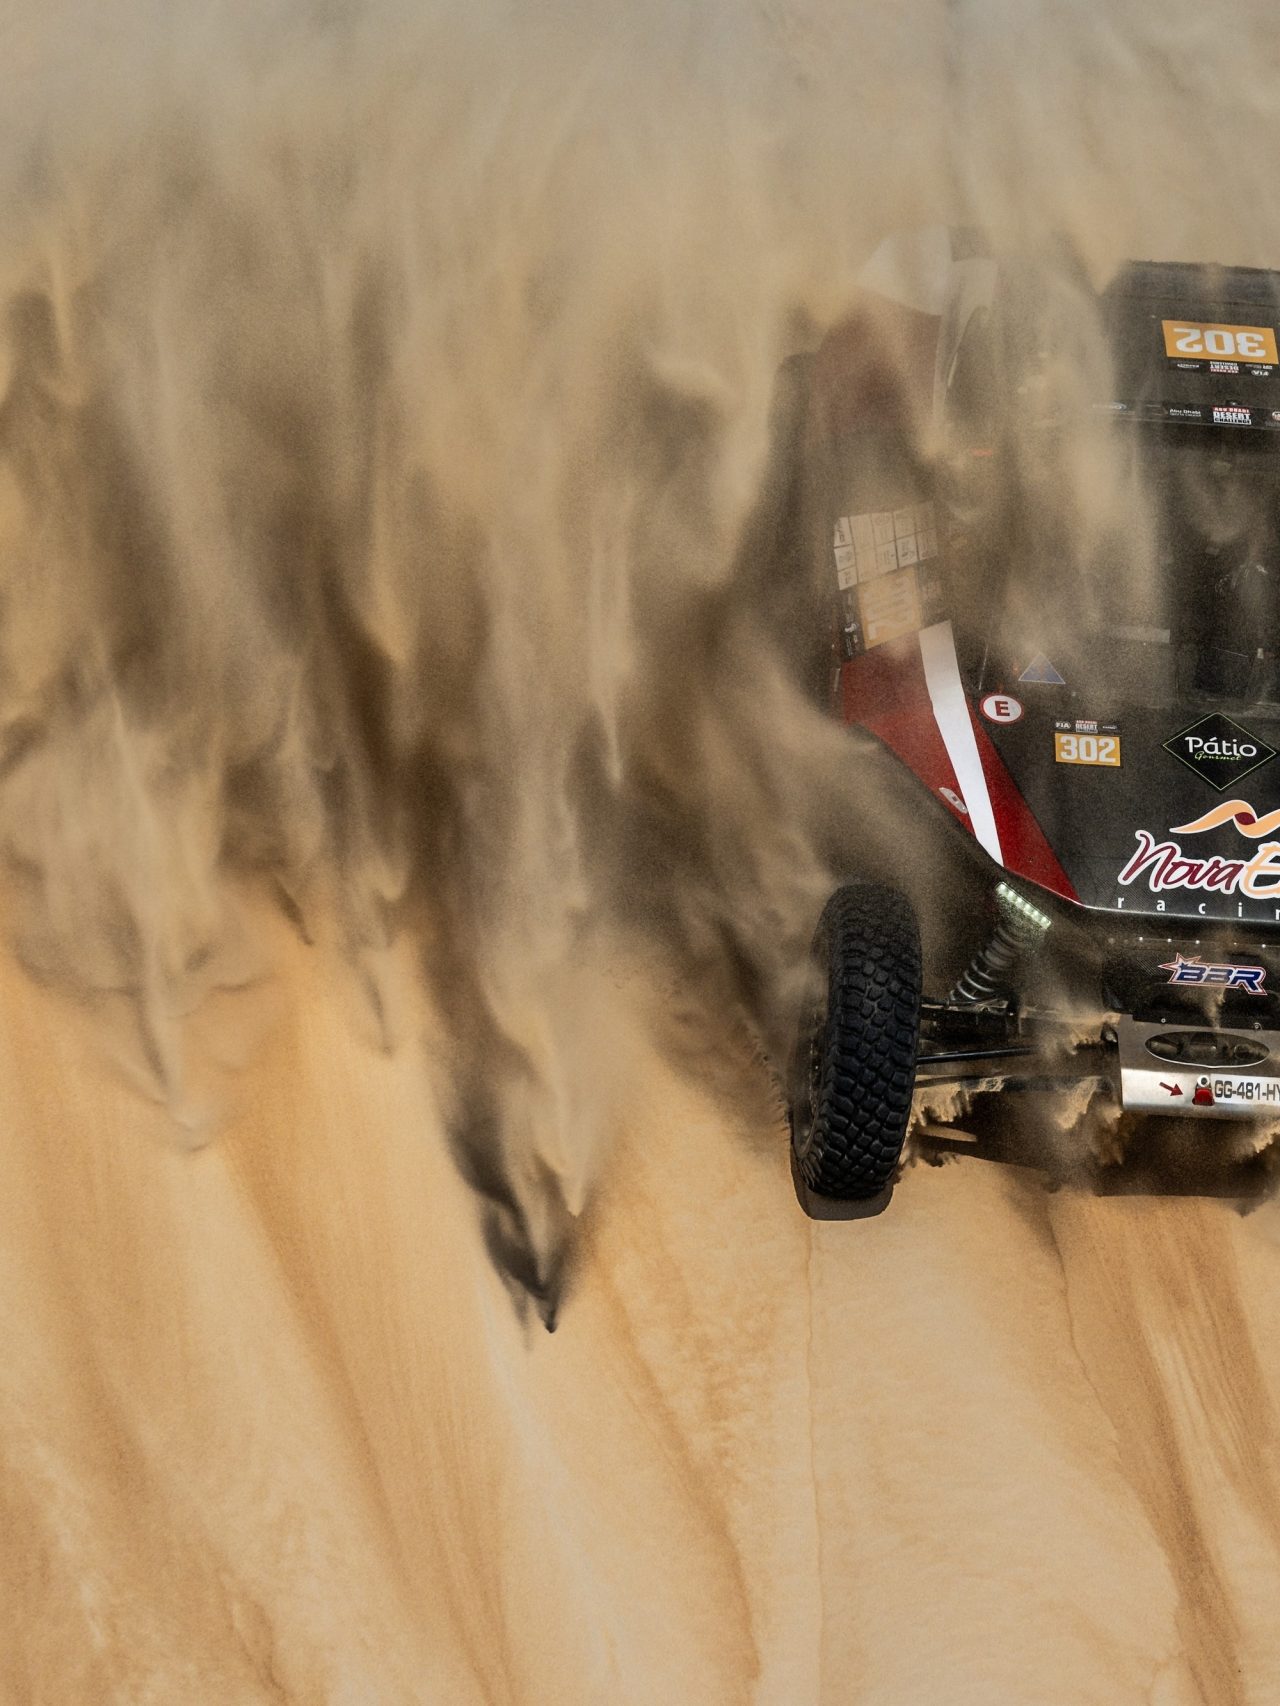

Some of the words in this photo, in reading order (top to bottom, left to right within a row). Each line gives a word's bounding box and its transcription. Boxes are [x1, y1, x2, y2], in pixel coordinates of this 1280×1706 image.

[1173, 328, 1266, 357] 302
[1213, 411, 1251, 420] DESERT
[995, 700, 1011, 717] E
[1060, 735, 1117, 763] 302
[1184, 736, 1257, 757] Pátio
[1173, 963, 1265, 993] BBR
